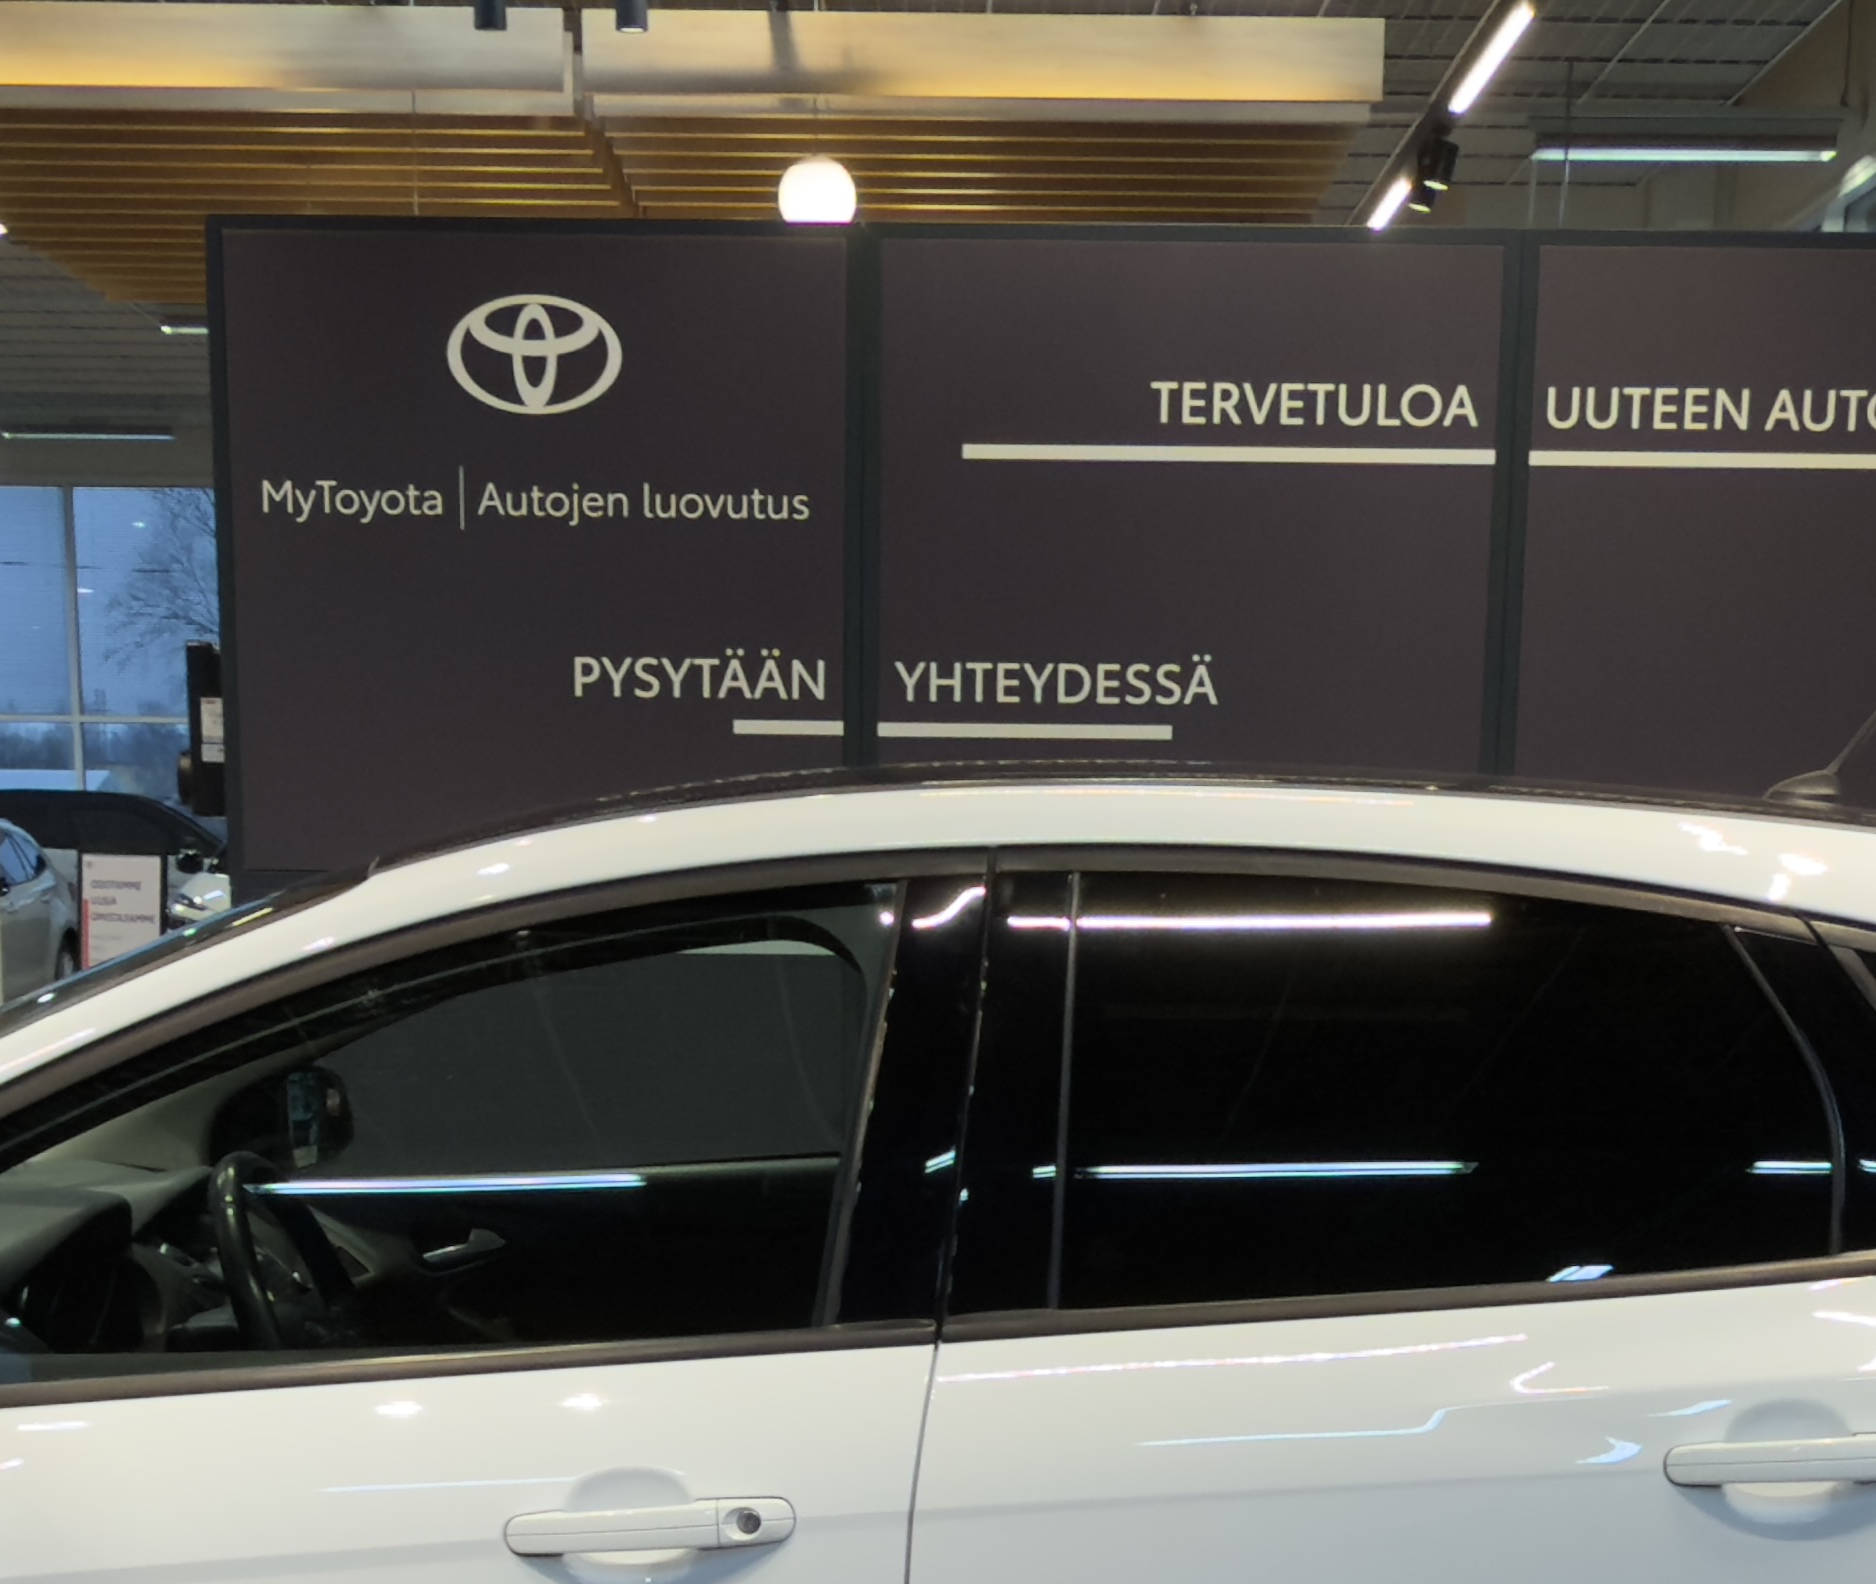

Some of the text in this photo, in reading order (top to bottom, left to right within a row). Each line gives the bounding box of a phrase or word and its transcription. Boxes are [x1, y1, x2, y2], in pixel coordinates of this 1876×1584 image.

[1150, 381, 1479, 428] TERVETULOA
[1546, 385, 1750, 431] UUTEEN
[260, 479, 810, 527] MyToyota Autojen luovutus
[573, 648, 826, 701] PYSYTÄÄN
[894, 653, 1219, 706] YHTEYDESSÄ
